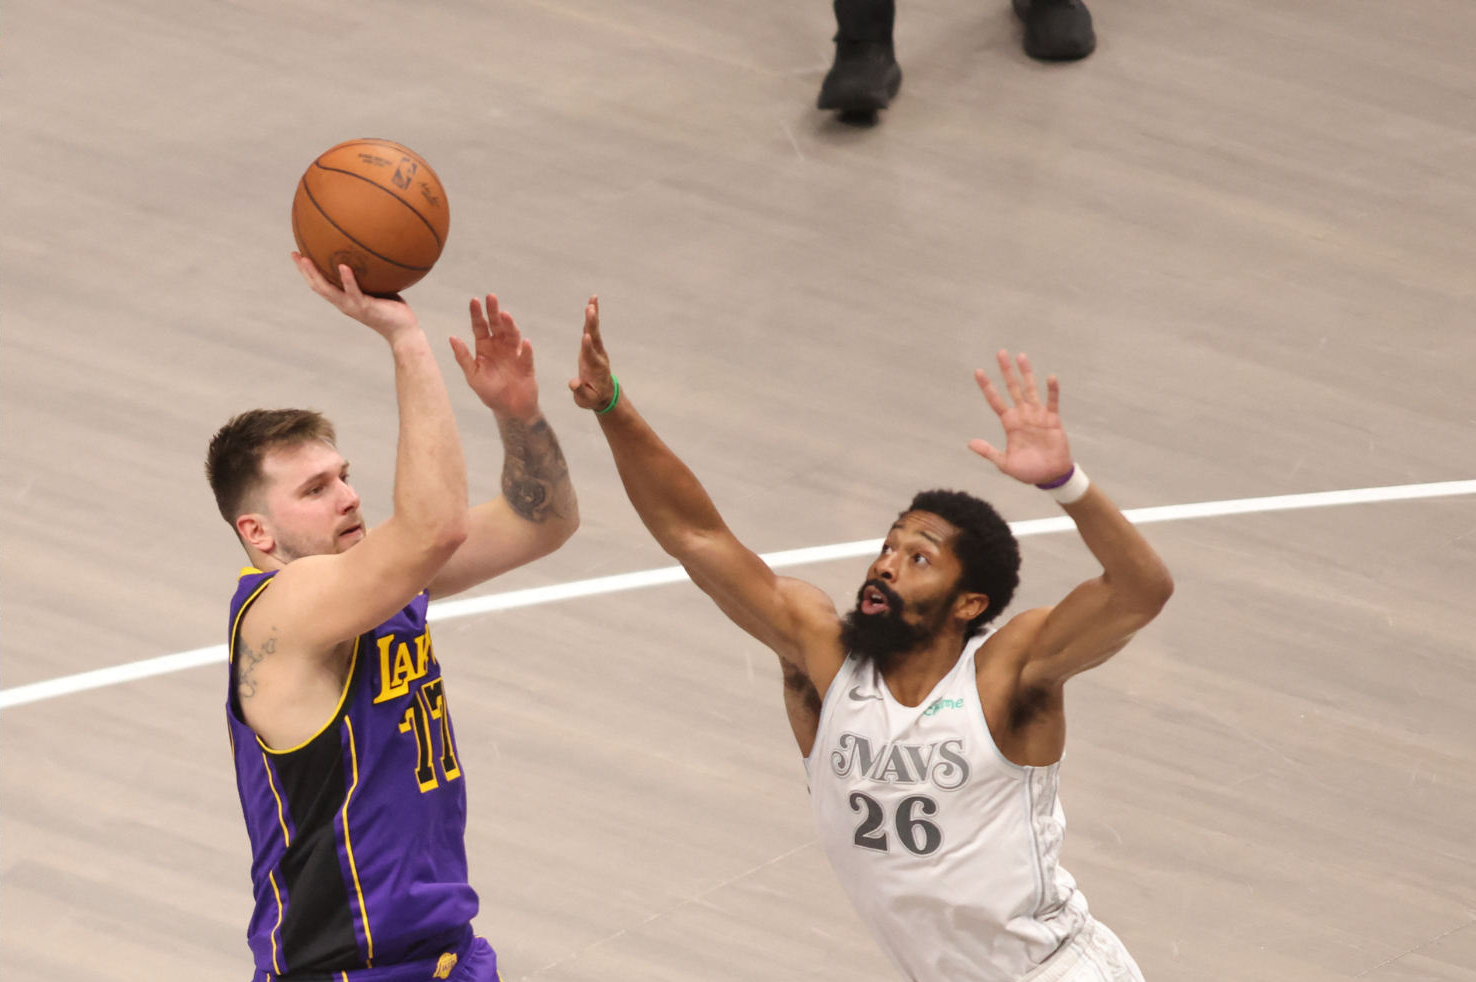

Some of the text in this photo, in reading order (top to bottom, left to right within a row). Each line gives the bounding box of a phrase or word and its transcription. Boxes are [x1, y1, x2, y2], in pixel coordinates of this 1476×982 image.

[398, 676, 461, 793] 77
[831, 731, 973, 792] MAVS
[849, 789, 944, 858] 26
